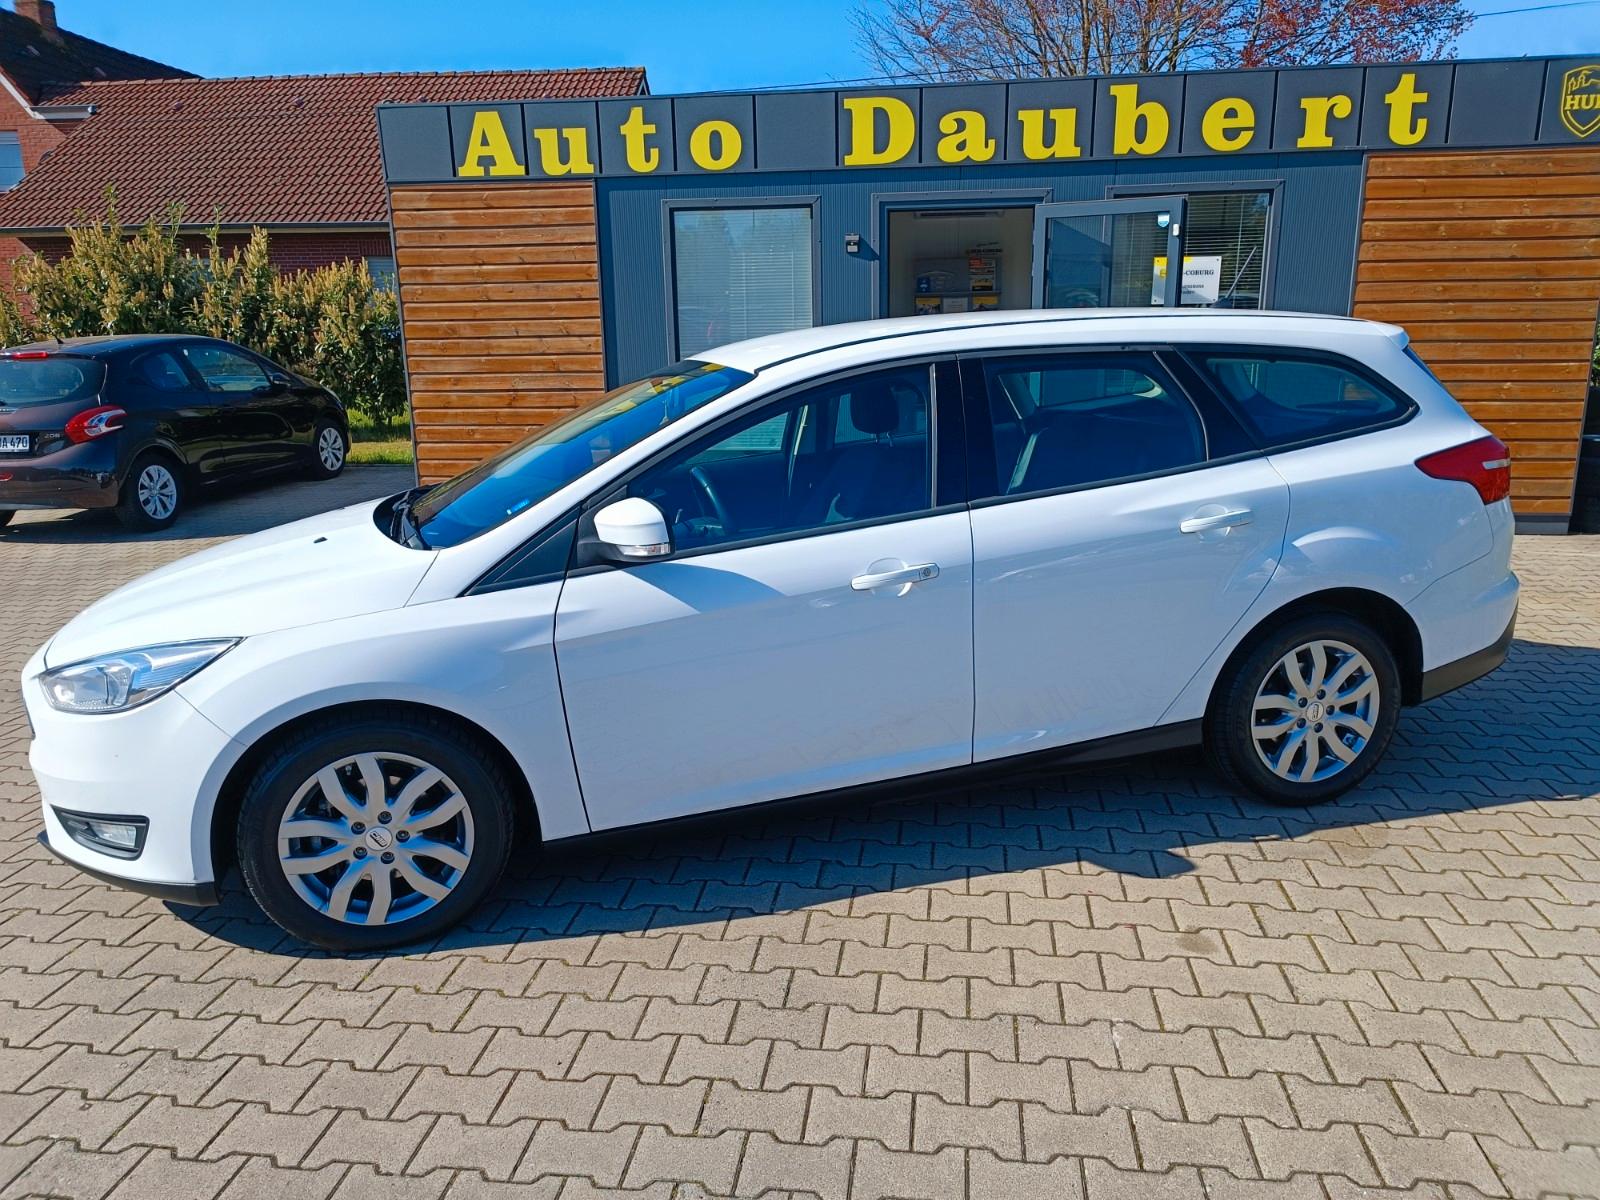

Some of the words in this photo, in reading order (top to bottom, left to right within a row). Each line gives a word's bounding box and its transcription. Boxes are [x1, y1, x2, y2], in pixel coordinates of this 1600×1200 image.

[1564, 94, 1600, 110] HU
[457, 106, 742, 177] Auto
[843, 73, 1429, 167] Daubert
[10, 436, 28, 449] 470
